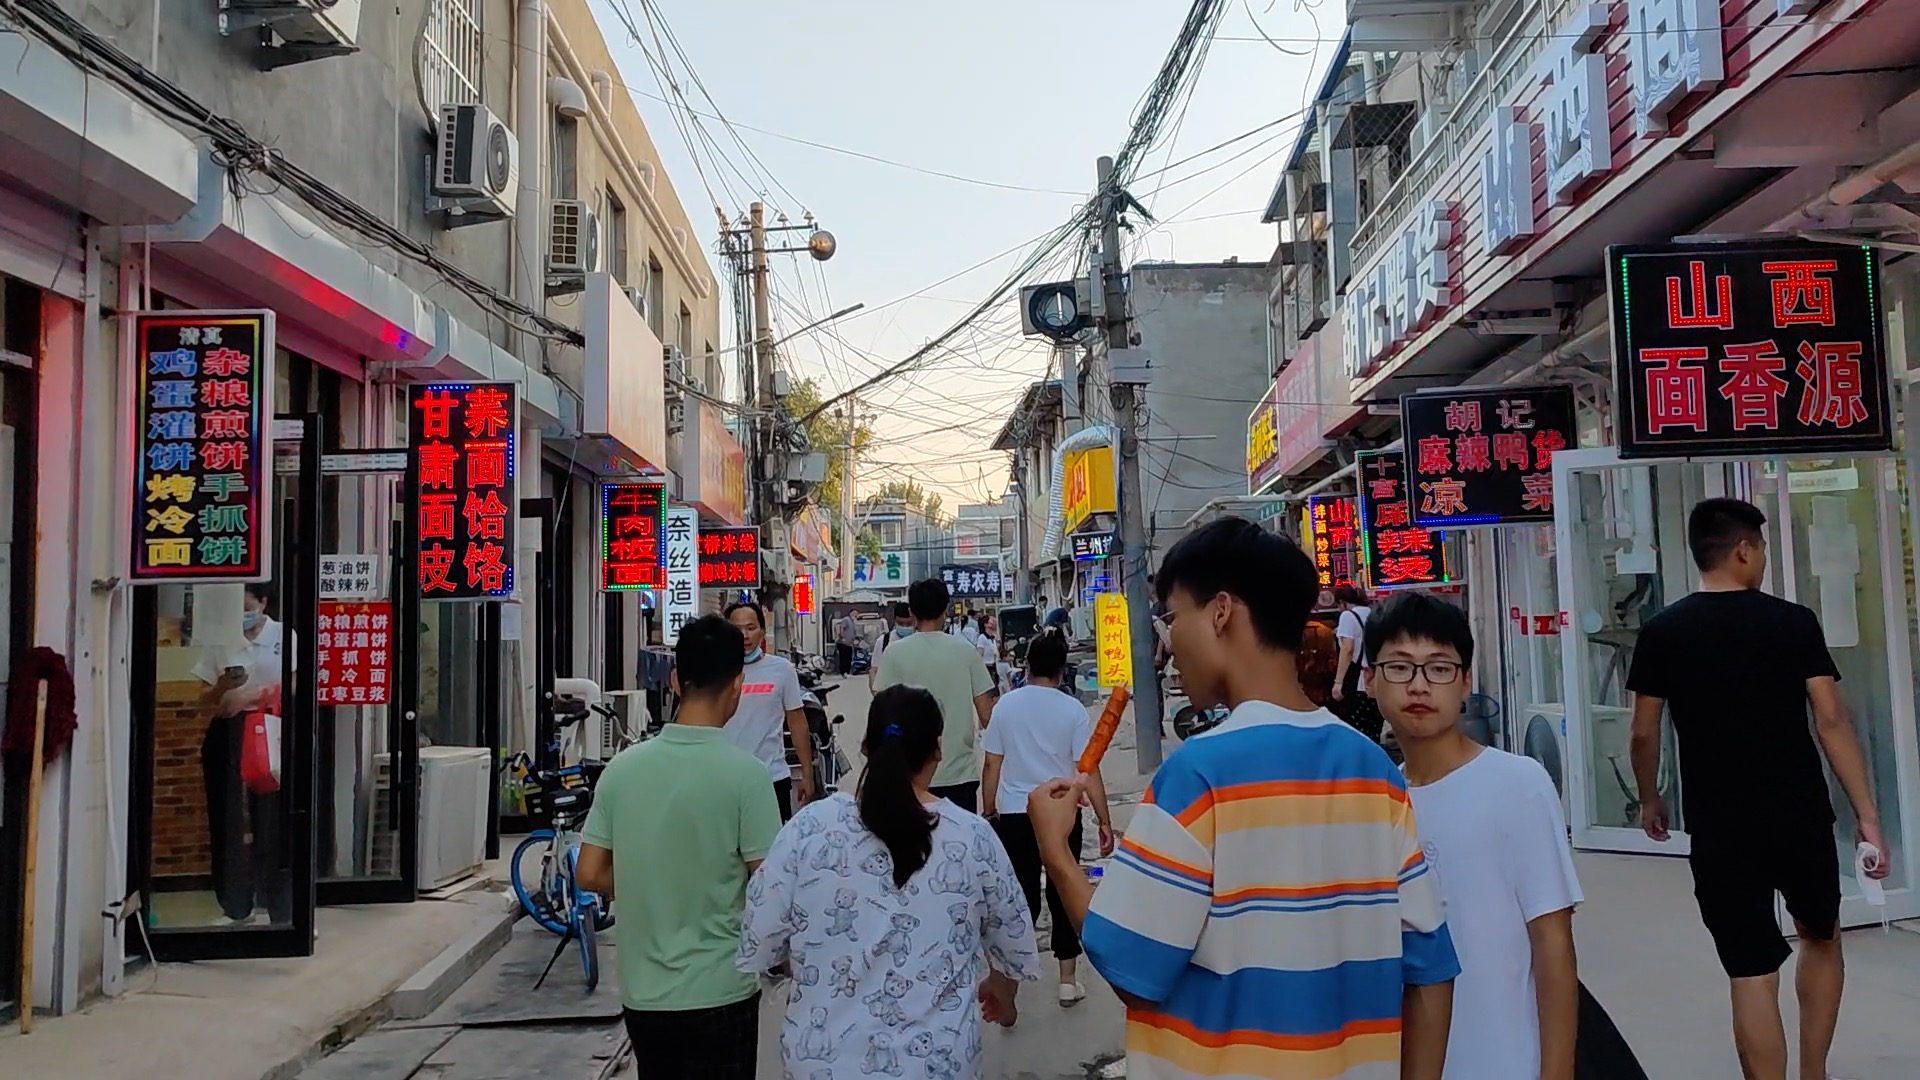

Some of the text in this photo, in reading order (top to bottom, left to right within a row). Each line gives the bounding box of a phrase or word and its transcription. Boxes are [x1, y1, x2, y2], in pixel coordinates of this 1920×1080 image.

[1666, 260, 1838, 329] 山西
[1444, 400, 1535, 431] 胡记
[1639, 339, 1869, 435] 面香源
[1418, 429, 1566, 474] 麻辣鸭货
[414, 390, 460, 592] 甘肃面皮
[463, 388, 508, 591] 荞面饸饹
[320, 578, 369, 592] 酸辣粉
[321, 561, 370, 576] 葱油饼
[668, 515, 692, 638] 奈丝造型
[318, 614, 389, 630] 杂粮煎饼
